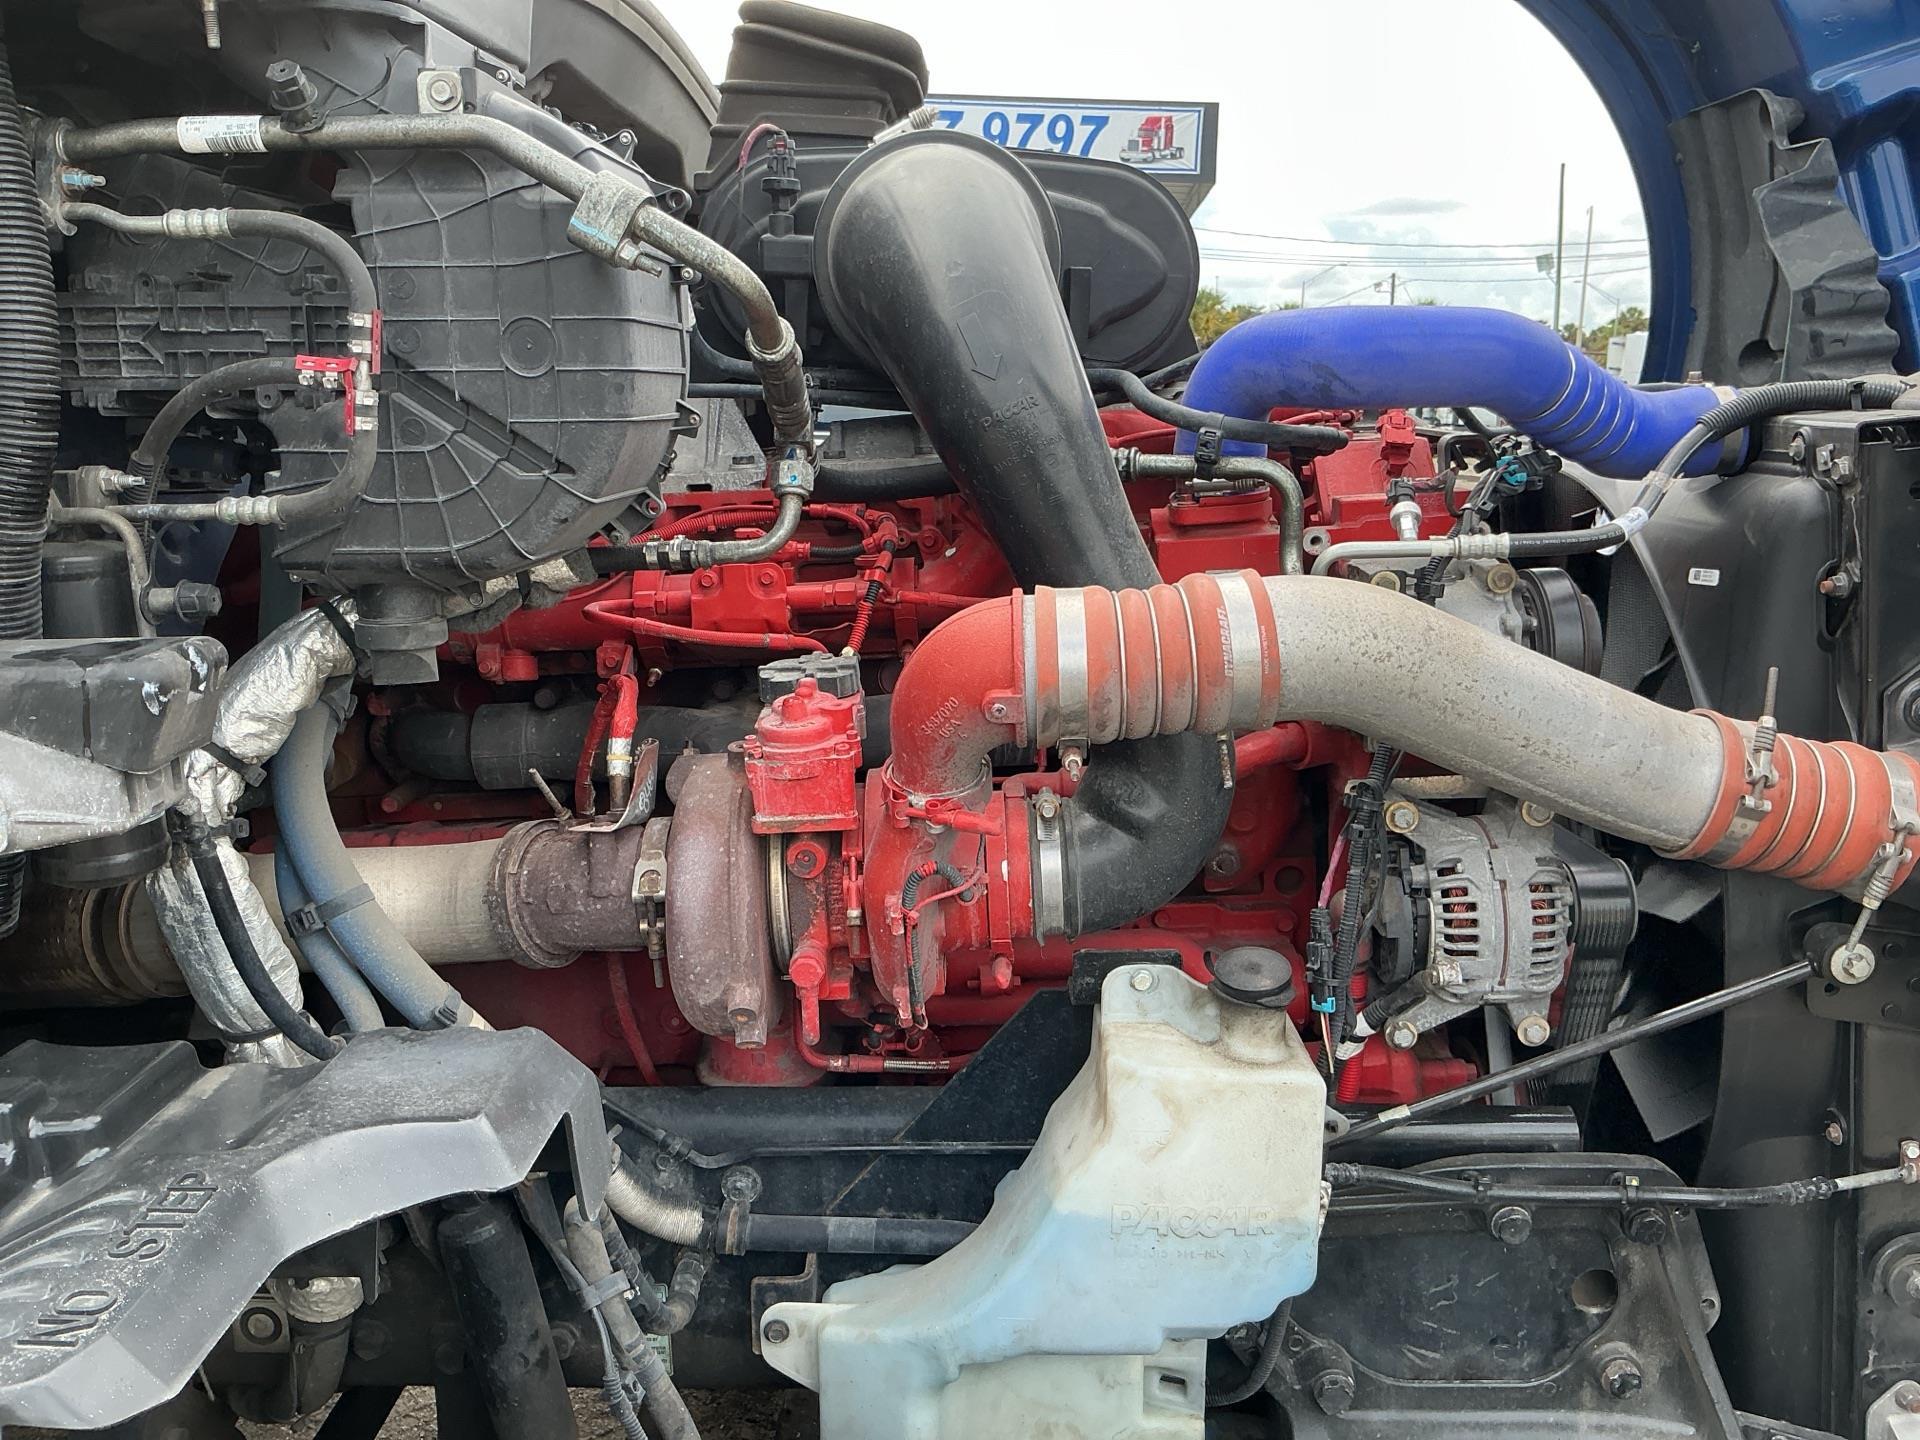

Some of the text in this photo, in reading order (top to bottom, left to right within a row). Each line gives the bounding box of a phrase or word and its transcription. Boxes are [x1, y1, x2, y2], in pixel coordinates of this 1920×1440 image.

[983, 112, 1110, 158] 9797
[981, 394, 1039, 432] PACCAR
[1216, 606, 1233, 677] DYNACRAFT
[940, 720, 962, 738] USA
[1111, 1203, 1274, 1238] PACCAR
[15, 1172, 218, 1347] NO STEP
